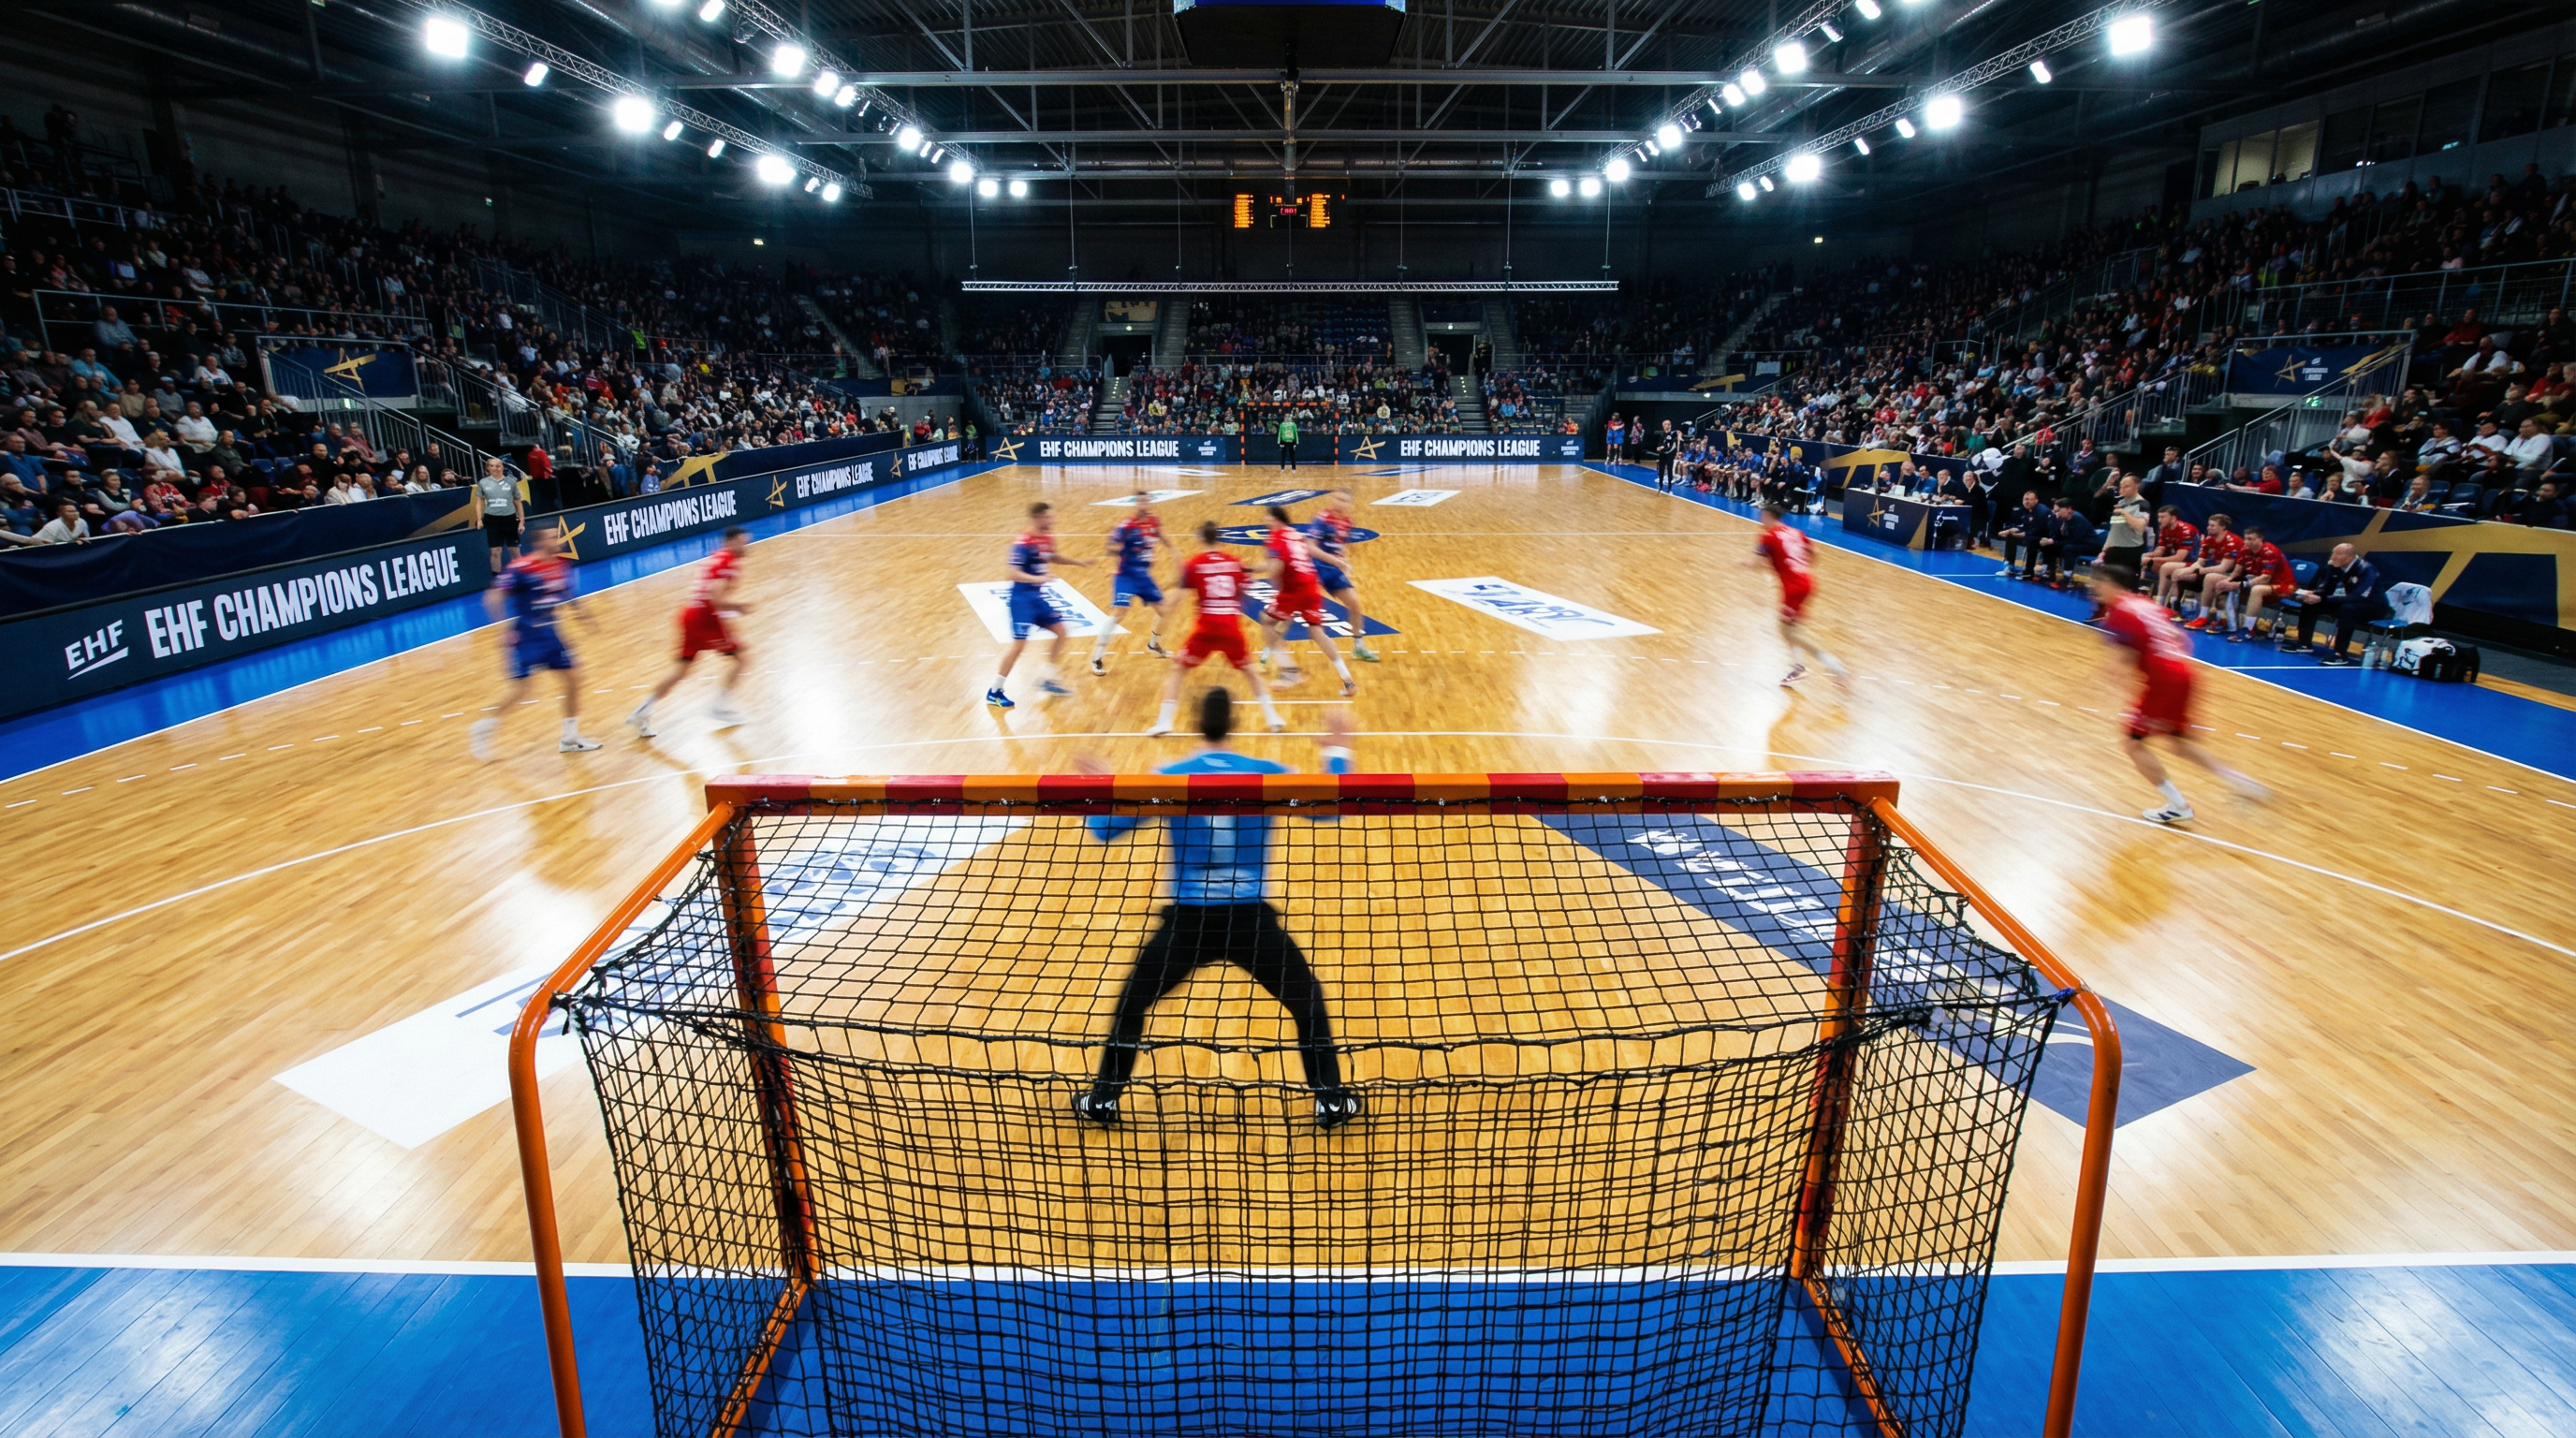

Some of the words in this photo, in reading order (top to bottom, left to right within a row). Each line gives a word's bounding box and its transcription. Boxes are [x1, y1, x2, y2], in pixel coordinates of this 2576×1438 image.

[1040, 440, 1062, 458] EHF
[1064, 440, 1134, 458] CHAMPIONS
[1136, 440, 1179, 458] LEAGUE
[1400, 439, 1422, 457] EHF
[1425, 439, 1495, 457] CHAMPIONS
[1498, 439, 1541, 457] LEAGUE
[603, 511, 629, 546] EHF
[630, 497, 699, 539] CHAMPIONS
[699, 490, 737, 522] LEAGUE
[144, 599, 208, 659] EHF
[213, 564, 379, 641] CHAMPIONS
[380, 546, 461, 601] LEAGUE
[65, 619, 124, 670] EHF
